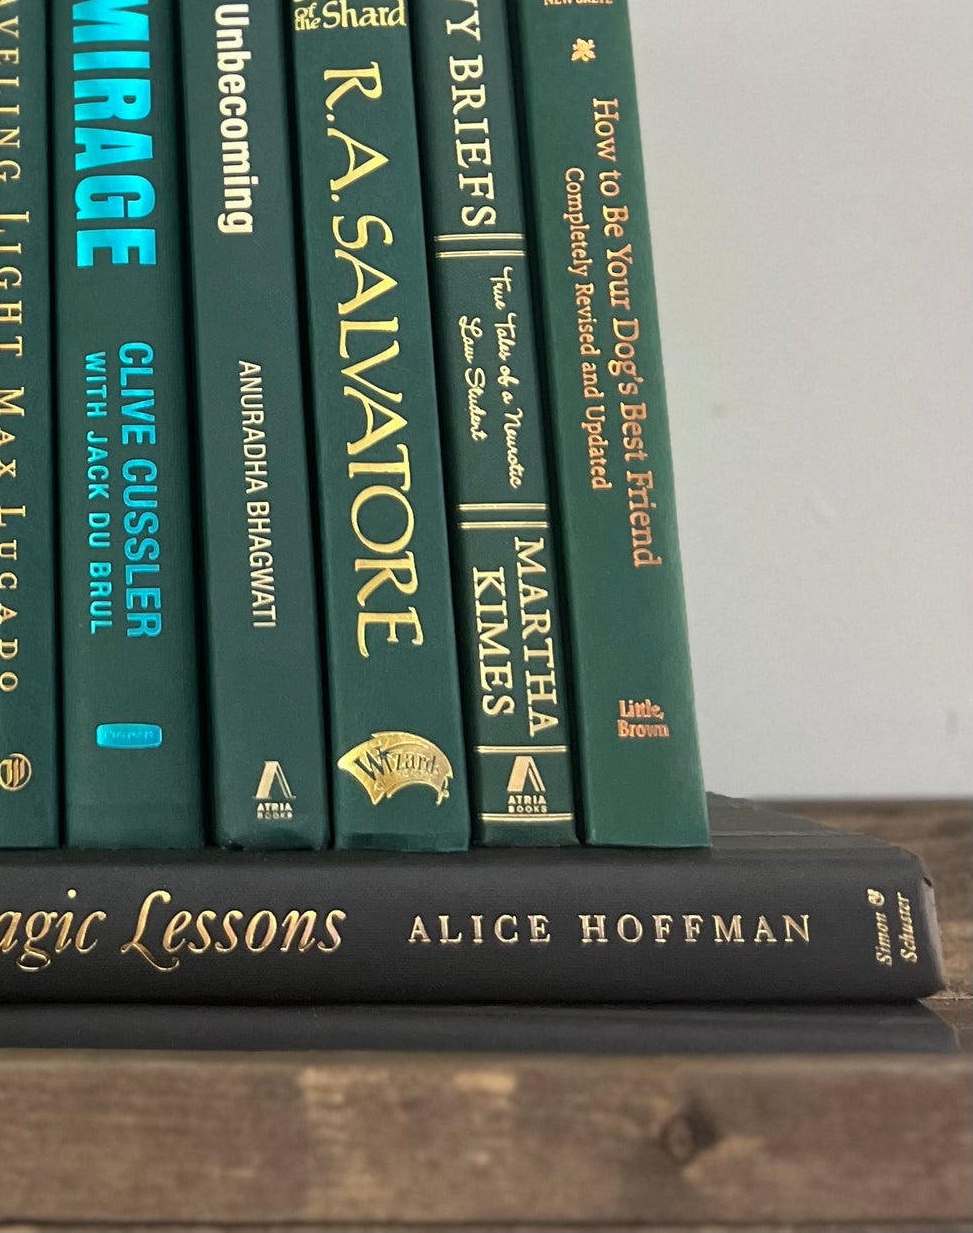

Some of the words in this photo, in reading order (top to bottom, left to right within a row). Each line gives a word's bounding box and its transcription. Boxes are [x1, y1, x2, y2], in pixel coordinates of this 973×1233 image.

[294, 2, 317, 18] of
[294, 14, 321, 31] the
[214, 4, 258, 234] Unbecoming
[449, 55, 497, 227] BRIEFS
[592, 97, 618, 162] How
[598, 169, 622, 197] to
[562, 167, 594, 278] Completely
[602, 205, 629, 238] Be
[490, 266, 514, 311] True
[606, 244, 634, 310] Your
[459, 315, 483, 364] Law
[494, 312, 517, 361] Tales
[575, 282, 601, 356] Revised
[85, 351, 107, 418] WITH
[497, 364, 519, 388] of
[581, 362, 605, 399] and
[608, 318, 644, 396] Dog's
[118, 342, 156, 445] CLIVE
[465, 368, 487, 441] Student
[501, 391, 514, 404] a
[238, 360, 268, 494] ANURADHA
[332, 214, 424, 657] SALVATORE
[503, 408, 525, 489] Neurotic
[581, 405, 613, 491] Updated
[620, 402, 648, 461] Best
[87, 430, 109, 500] JACK
[88, 512, 111, 548] DU
[122, 458, 162, 638] CUSSLER
[627, 470, 663, 568] Friend
[247, 501, 277, 628] BHAGWATI
[89, 562, 112, 634] BRUL
[472, 566, 514, 717] KIMES
[514, 536, 559, 737] MARTHA
[617, 719, 670, 738] Brown
[619, 698, 665, 720] Little,
[257, 802, 293, 811] ATRIA
[507, 795, 547, 805] ATRIA
[508, 805, 548, 813] BOOKS
[120, 889, 347, 970] Lessons
[409, 912, 551, 946] ALICE
[579, 912, 812, 946] HOFFMAN
[867, 888, 885, 907] &
[897, 891, 918, 963] Schuster
[875, 911, 892, 967] Simon
